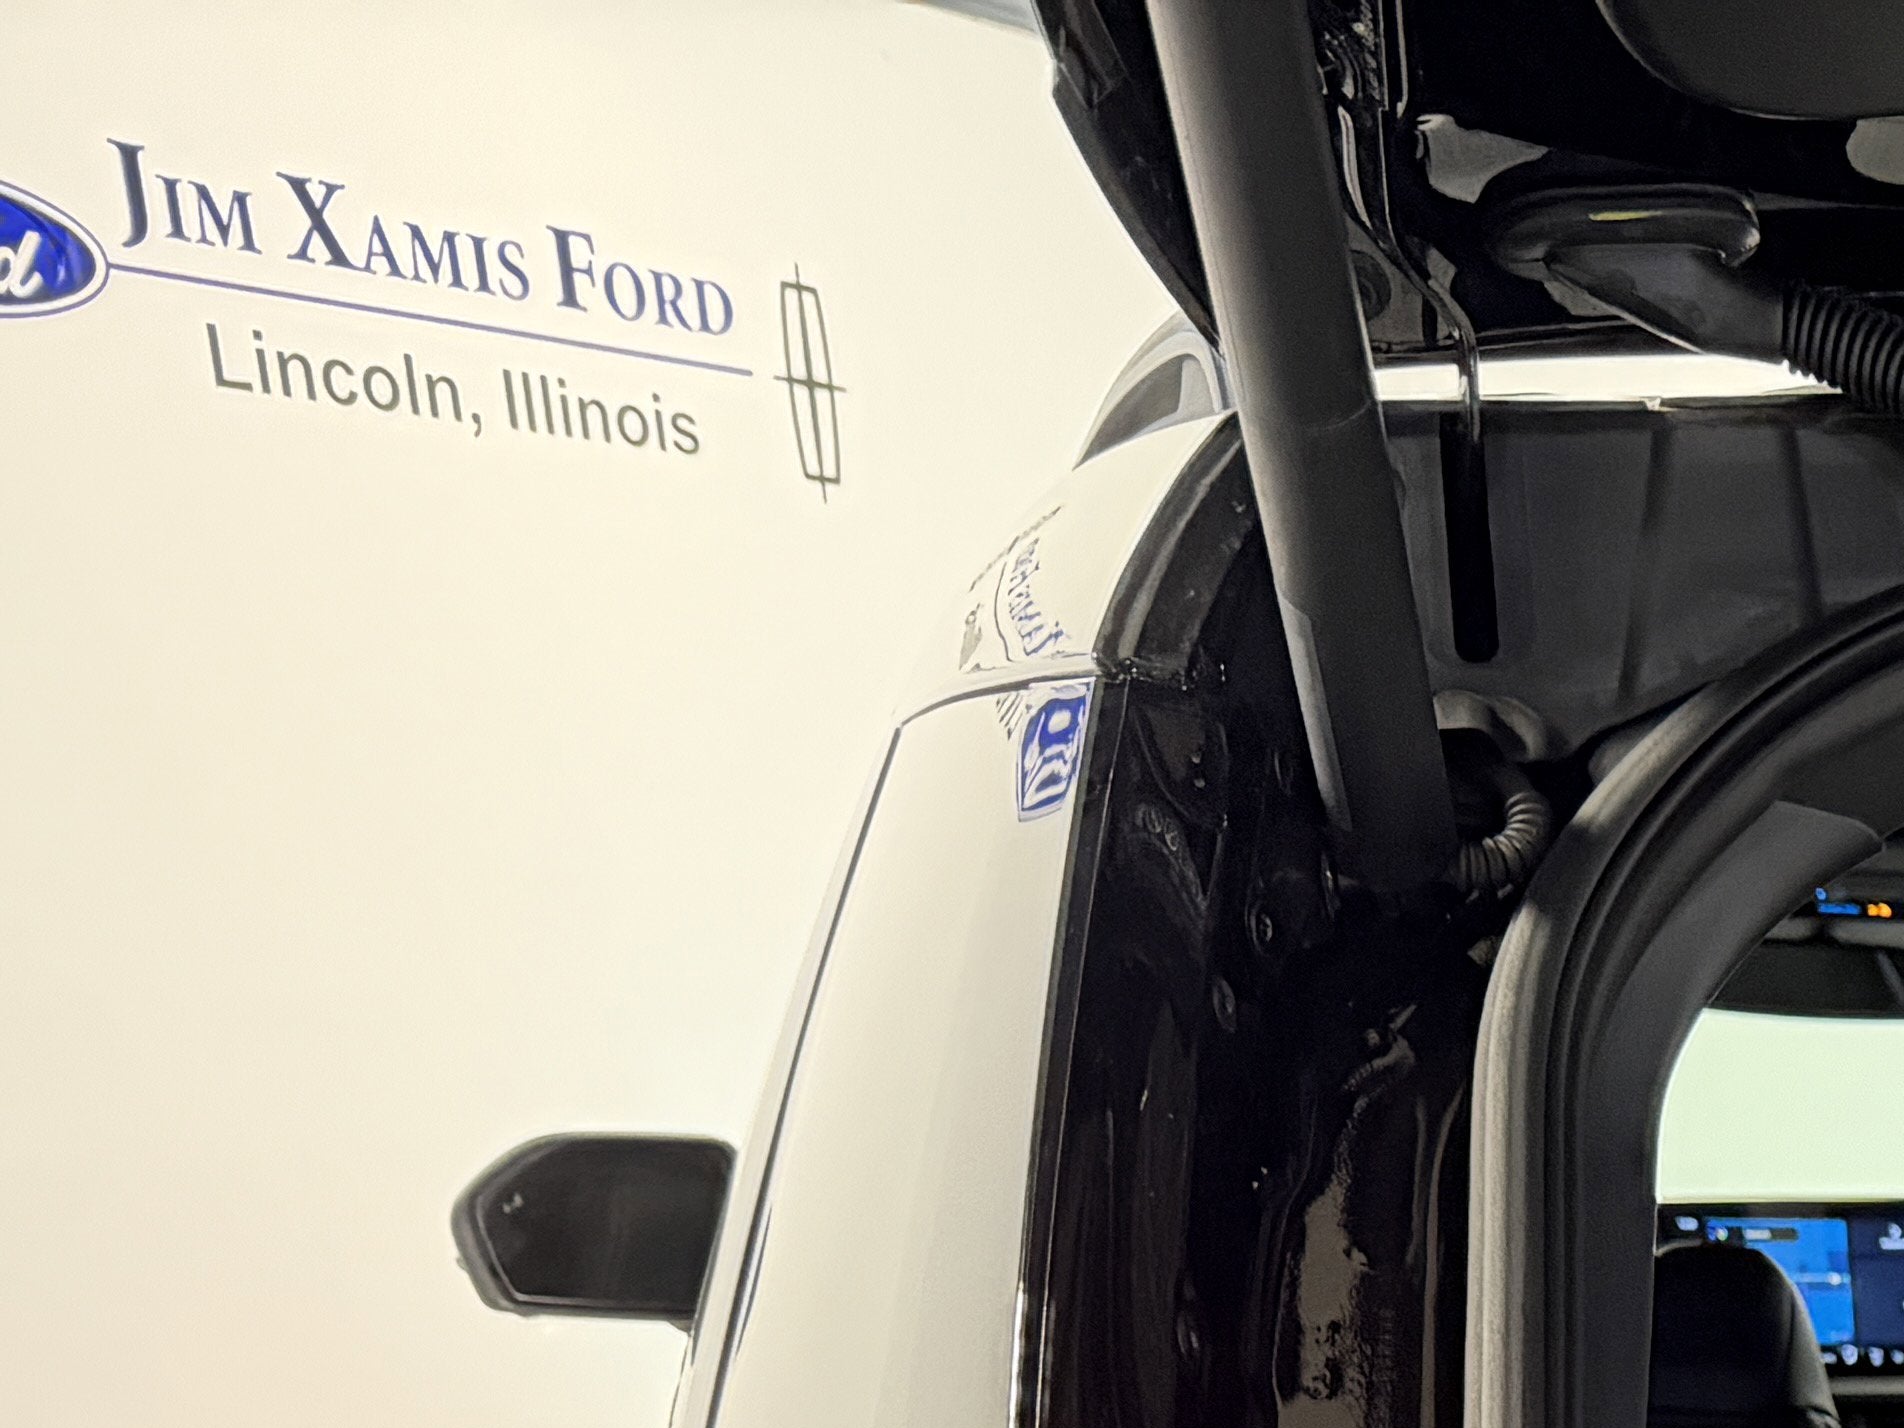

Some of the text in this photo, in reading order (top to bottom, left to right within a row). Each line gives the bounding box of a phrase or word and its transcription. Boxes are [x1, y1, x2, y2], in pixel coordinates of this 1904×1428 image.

[107, 137, 734, 336] JIM XAMIS FORD
[206, 322, 700, 455] Lincoln, Illinois
